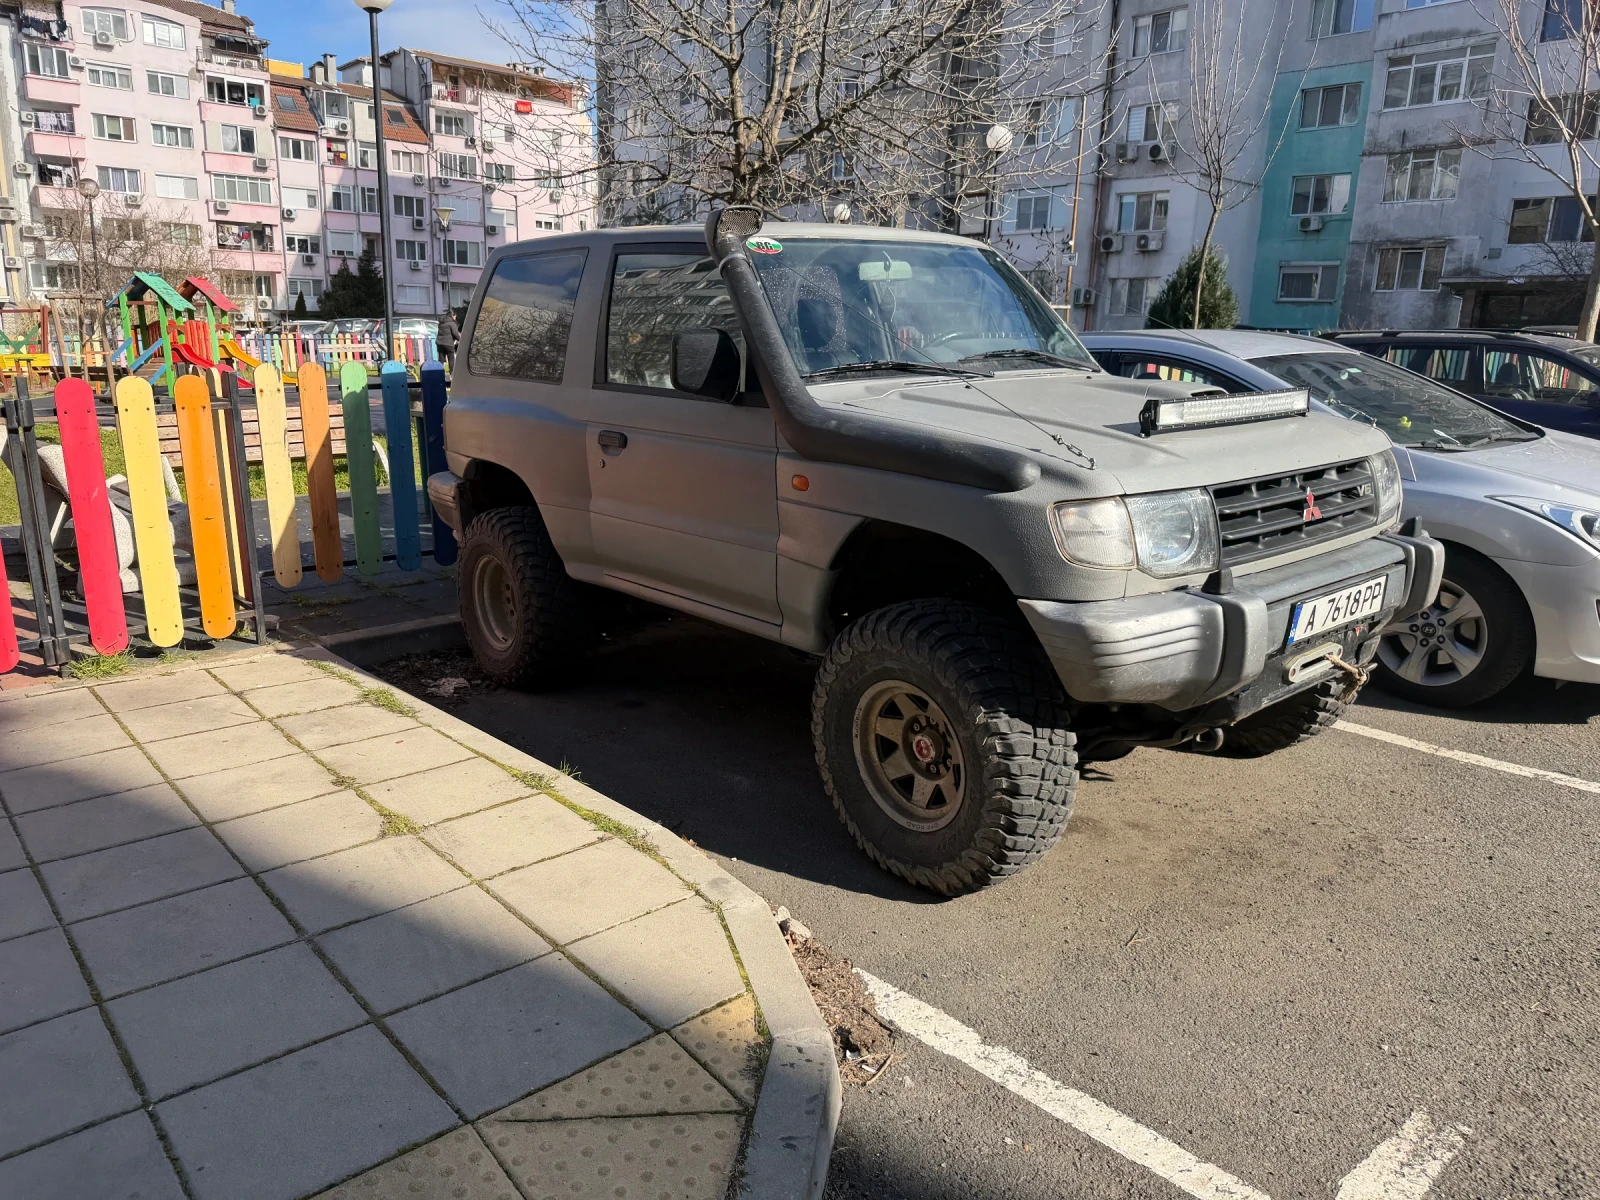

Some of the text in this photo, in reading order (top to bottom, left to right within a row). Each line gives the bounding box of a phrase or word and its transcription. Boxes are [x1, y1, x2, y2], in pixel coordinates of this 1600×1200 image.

[755, 241, 774, 251] BG
[1357, 483, 1372, 497] V6
[1303, 604, 1317, 634] A
[906, 821, 939, 830] OFF ROAD
